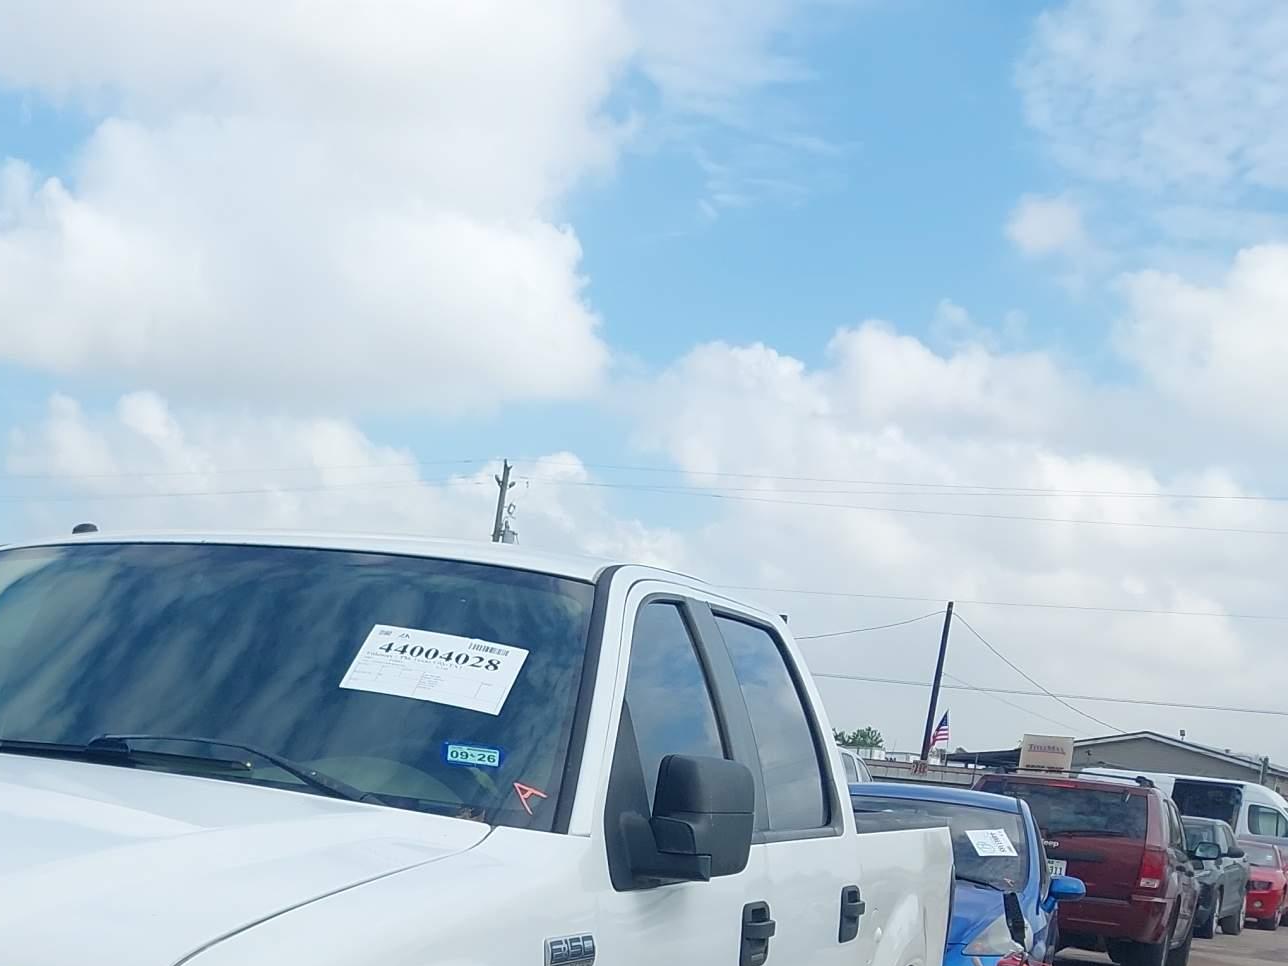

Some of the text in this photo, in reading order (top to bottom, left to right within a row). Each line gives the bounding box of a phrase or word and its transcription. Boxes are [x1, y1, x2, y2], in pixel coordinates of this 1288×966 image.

[379, 641, 501, 671] 44004028
[450, 750, 496, 763] 09 26
[1043, 840, 1059, 848] eep
